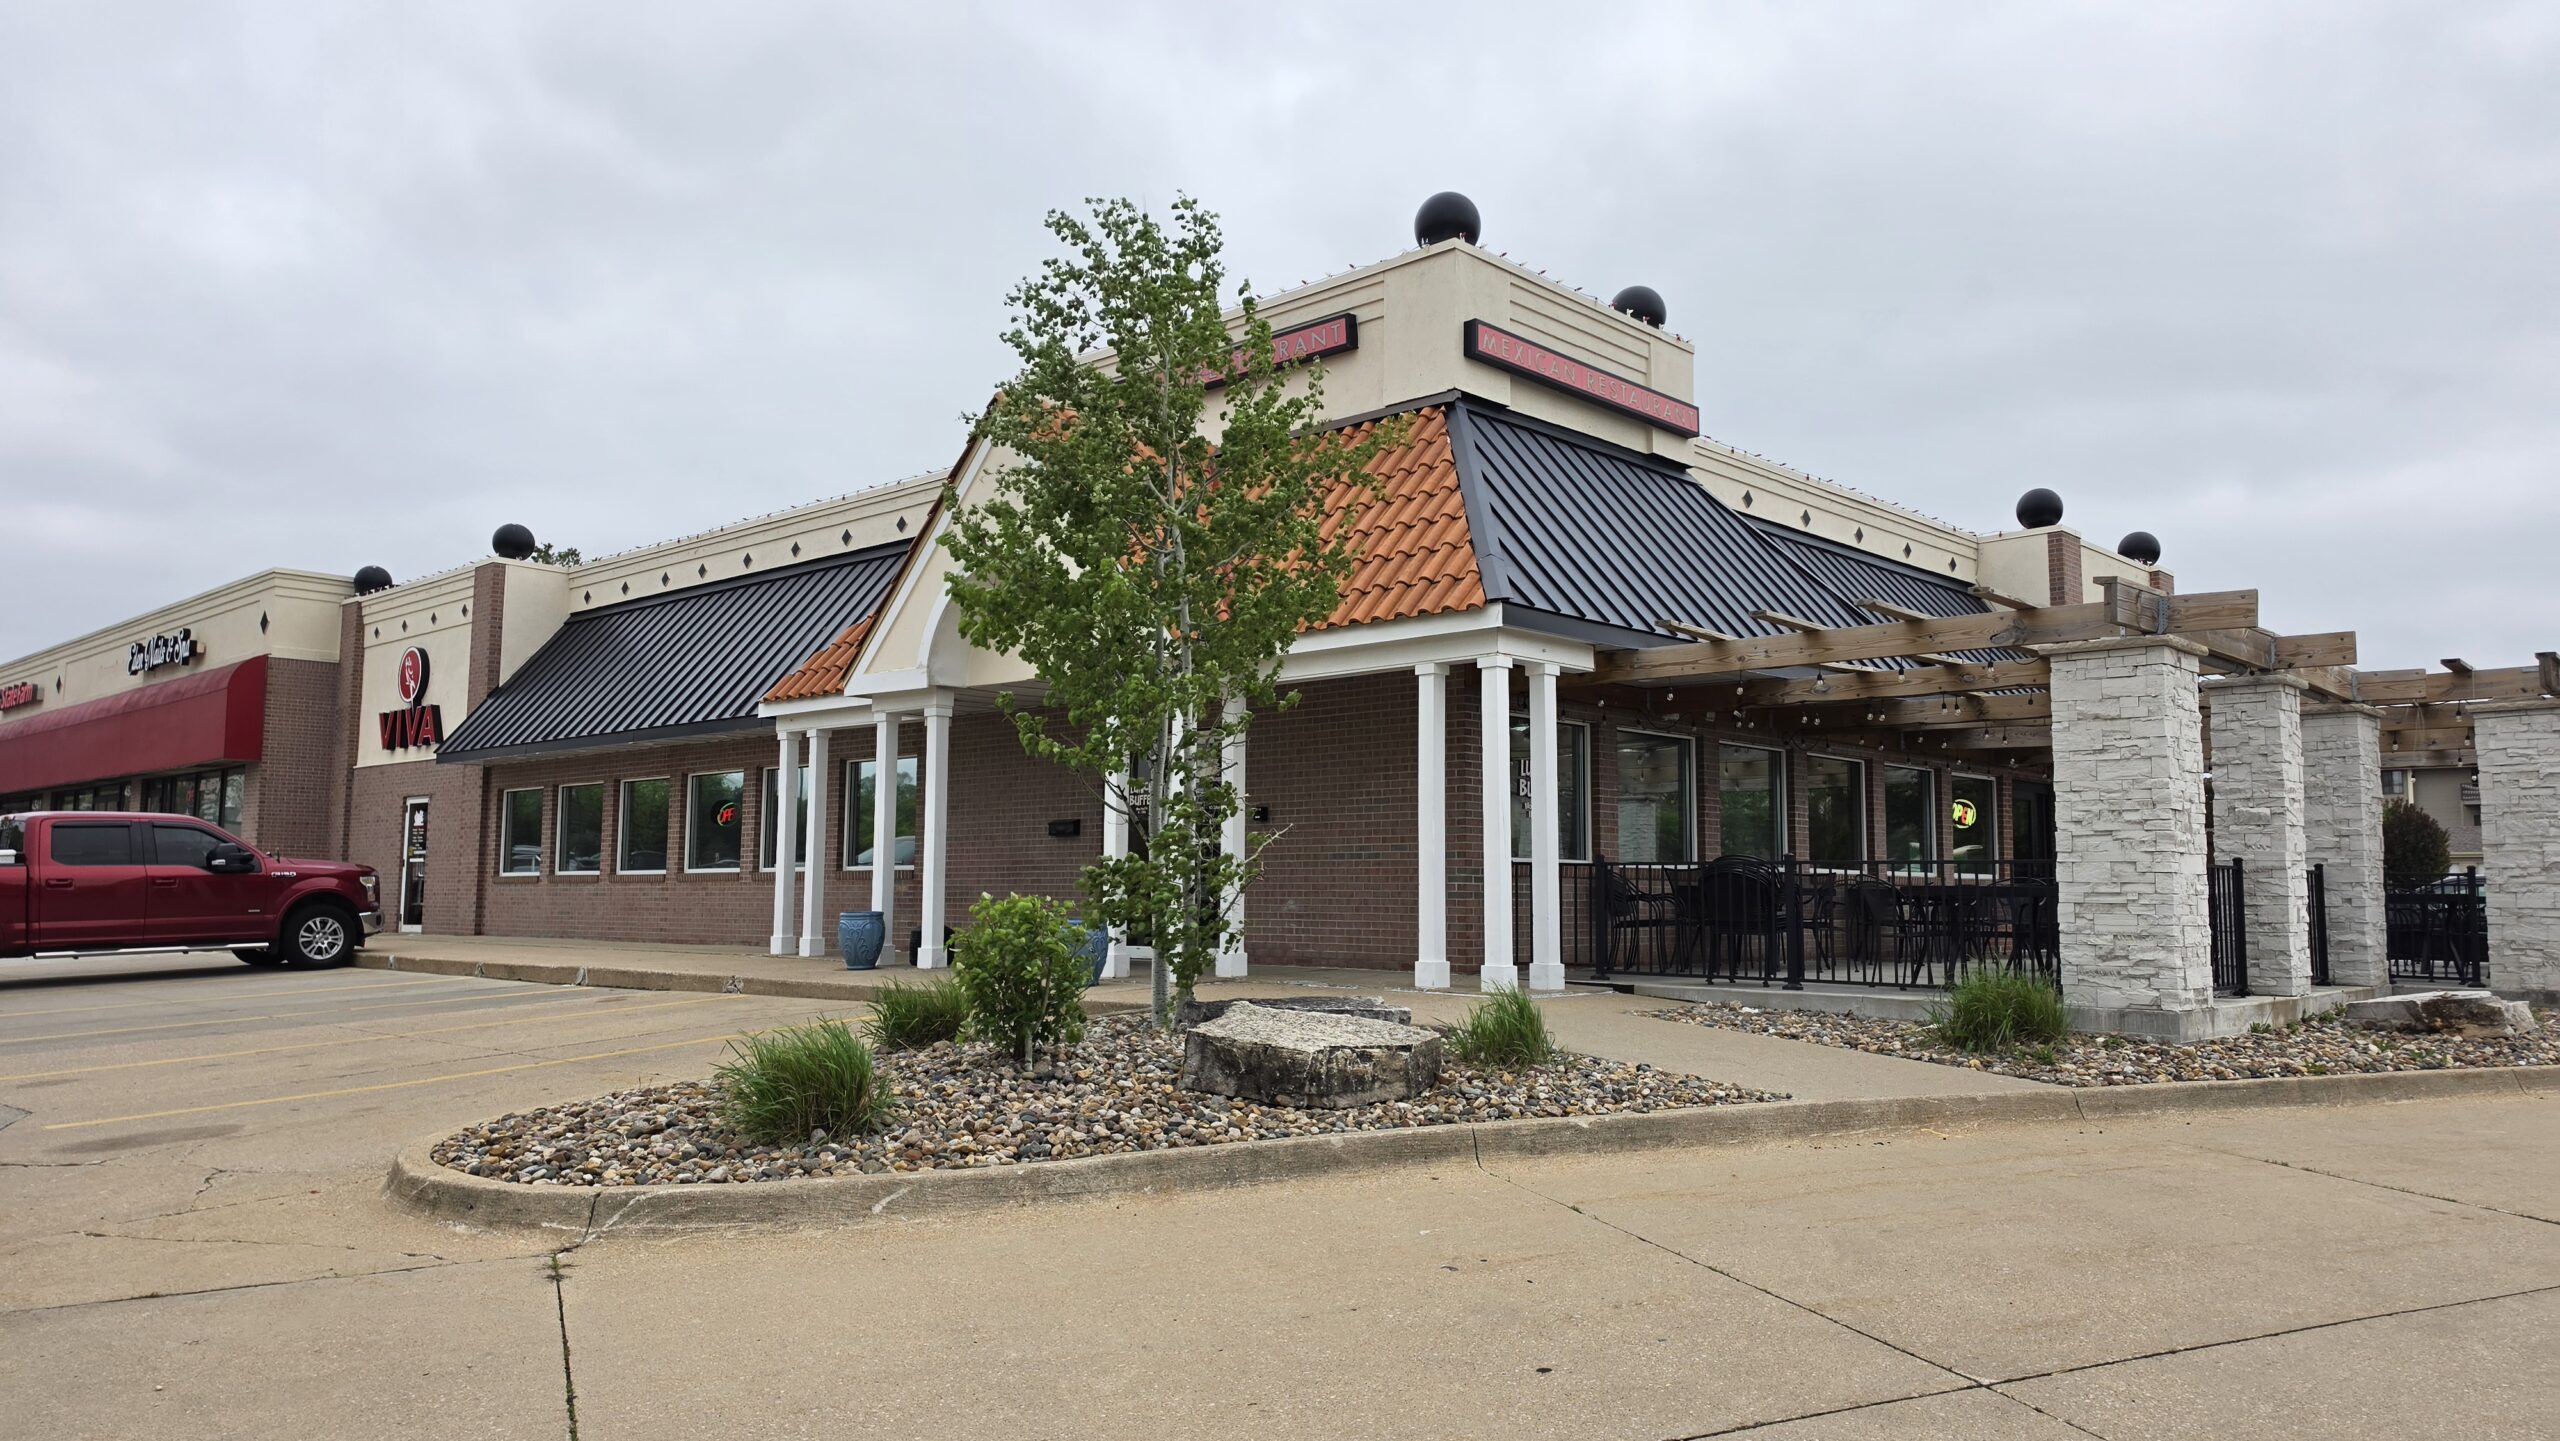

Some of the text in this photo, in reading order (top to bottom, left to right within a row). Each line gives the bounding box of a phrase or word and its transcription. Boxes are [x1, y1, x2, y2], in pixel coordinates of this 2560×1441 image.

[1482, 331, 1696, 429] MEXICAN RESTAURANT
[144, 634, 166, 671] Nails
[379, 704, 436, 751] VIVA
[1129, 794, 1151, 806] BUFFE
